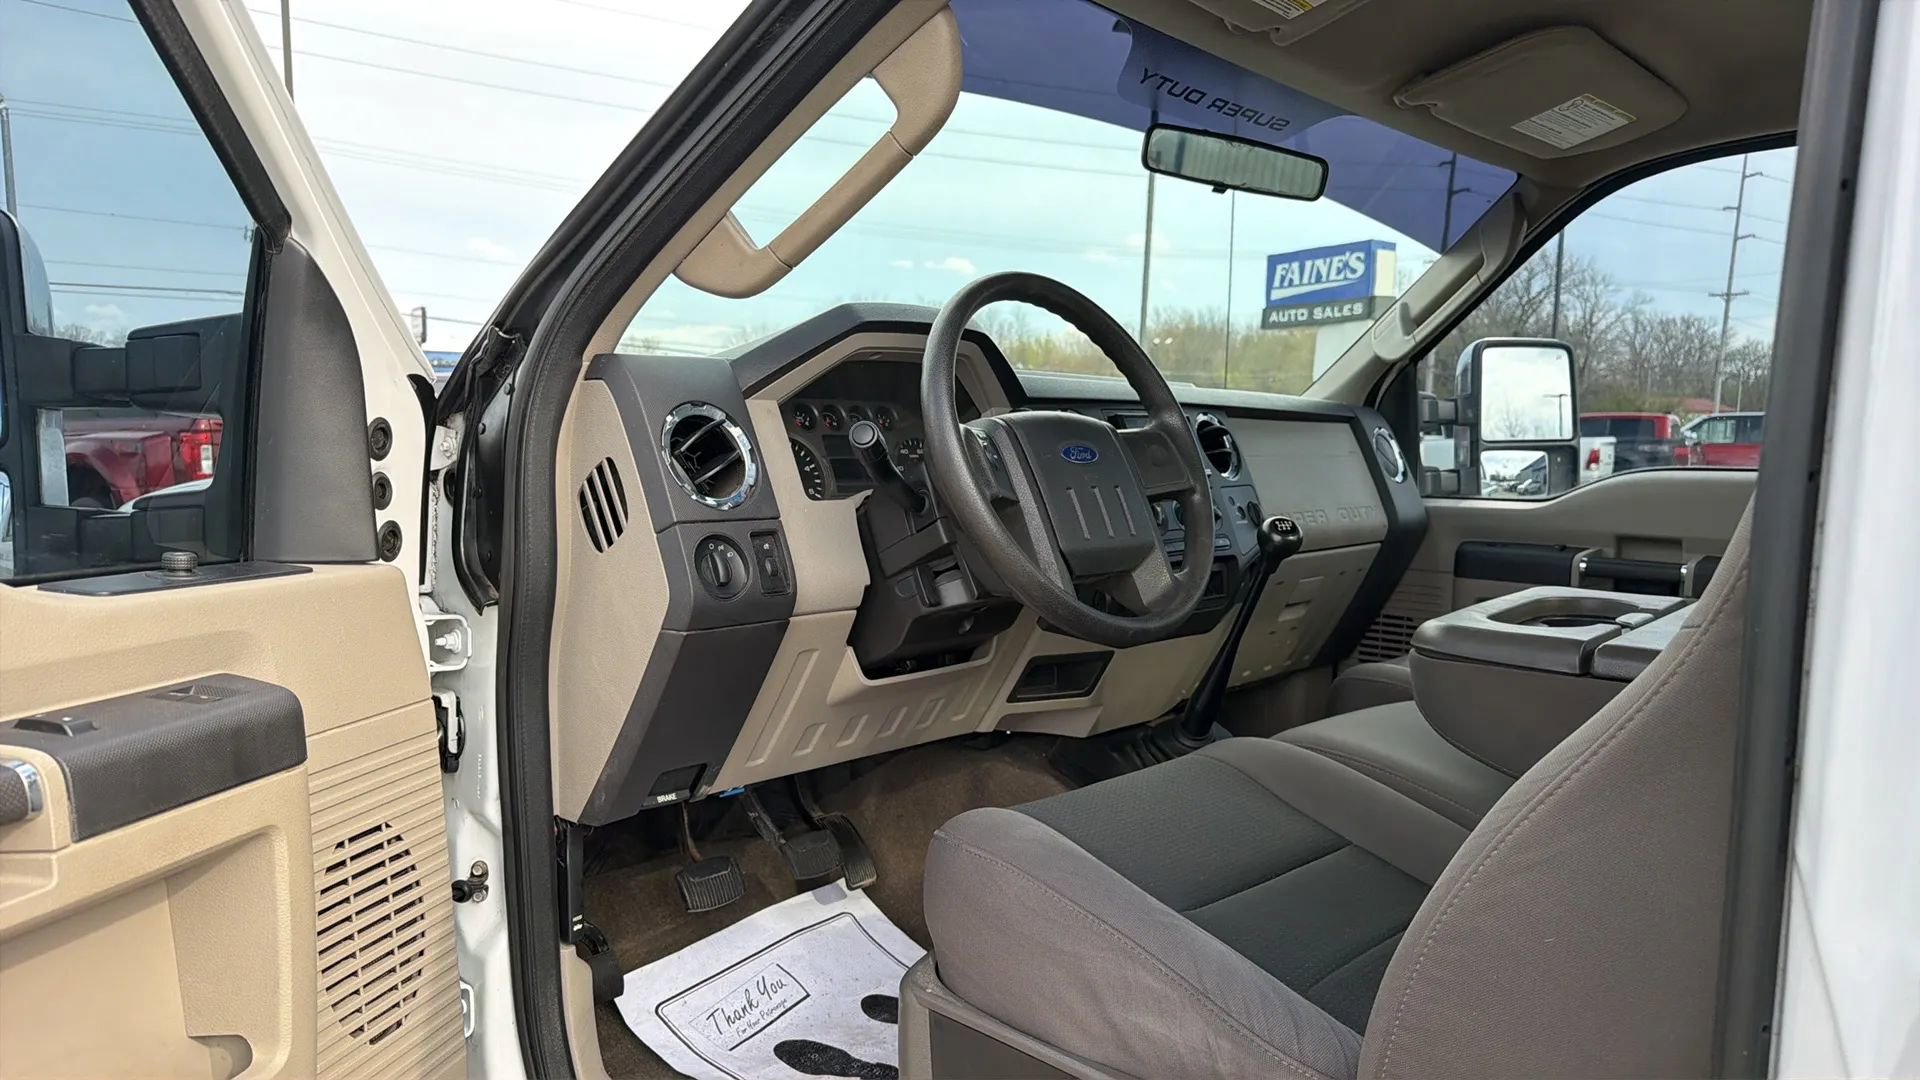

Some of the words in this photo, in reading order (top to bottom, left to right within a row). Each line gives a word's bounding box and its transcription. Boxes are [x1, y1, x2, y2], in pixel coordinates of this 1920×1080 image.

[1272, 250, 1366, 289] FAINE'S
[1268, 308, 1308, 323] AUTO
[1313, 302, 1363, 320] SALES
[1069, 447, 1092, 460] Ford
[1336, 505, 1377, 522] DUTY
[656, 792, 678, 803] BRAKE
[706, 988, 759, 1035] Thank
[756, 975, 788, 1001] You
